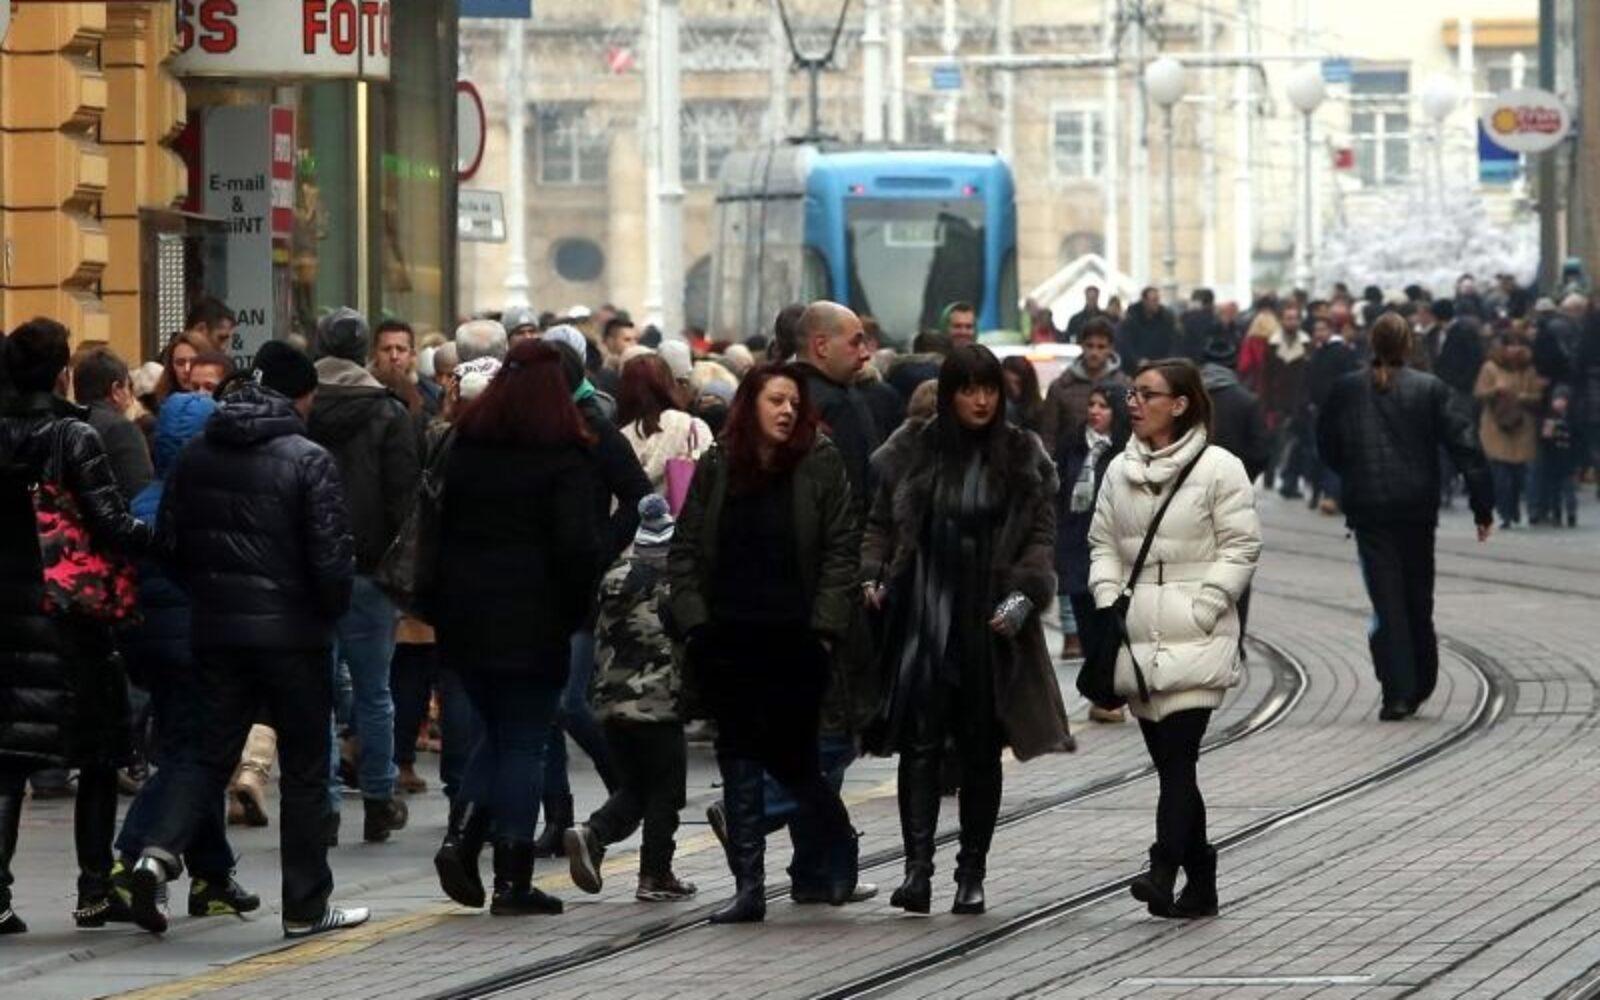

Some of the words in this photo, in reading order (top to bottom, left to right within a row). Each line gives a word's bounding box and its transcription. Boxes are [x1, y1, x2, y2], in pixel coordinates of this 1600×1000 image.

[209, 174, 265, 191] E-mail
[231, 195, 244, 212] &
[237, 309, 265, 326] AN
[231, 332, 243, 350] &
